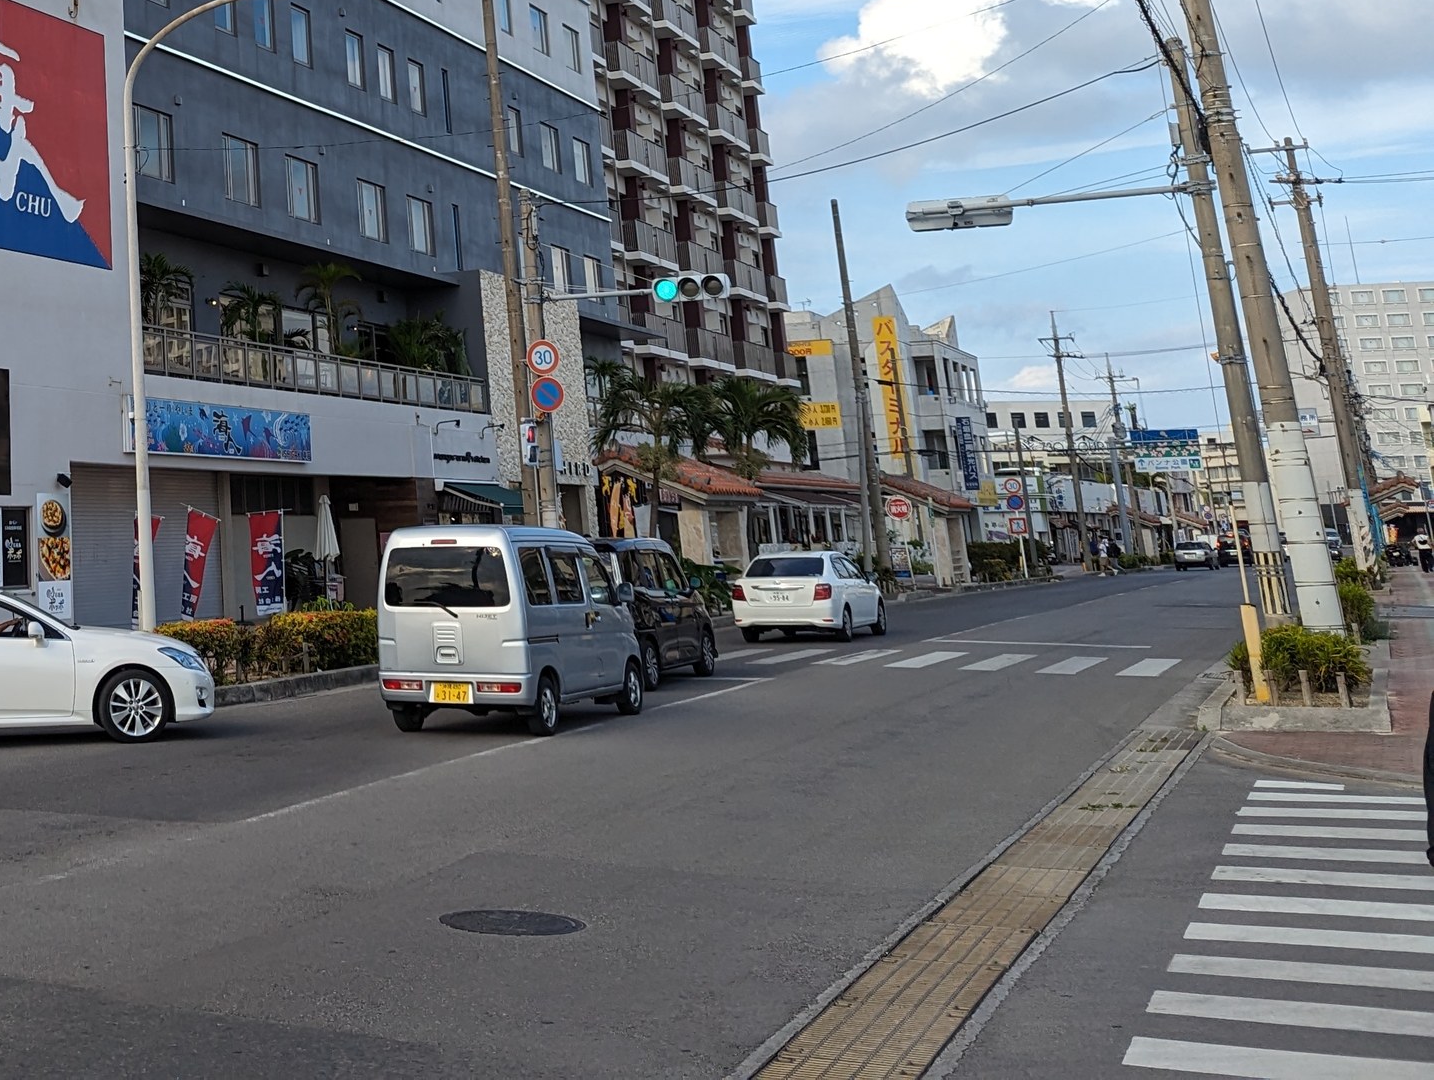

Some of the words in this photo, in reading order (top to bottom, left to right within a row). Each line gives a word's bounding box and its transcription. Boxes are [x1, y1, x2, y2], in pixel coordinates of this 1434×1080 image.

[15, 191, 51, 218] CHU
[534, 350, 553, 366] 30
[1007, 482, 1017, 490] 30
